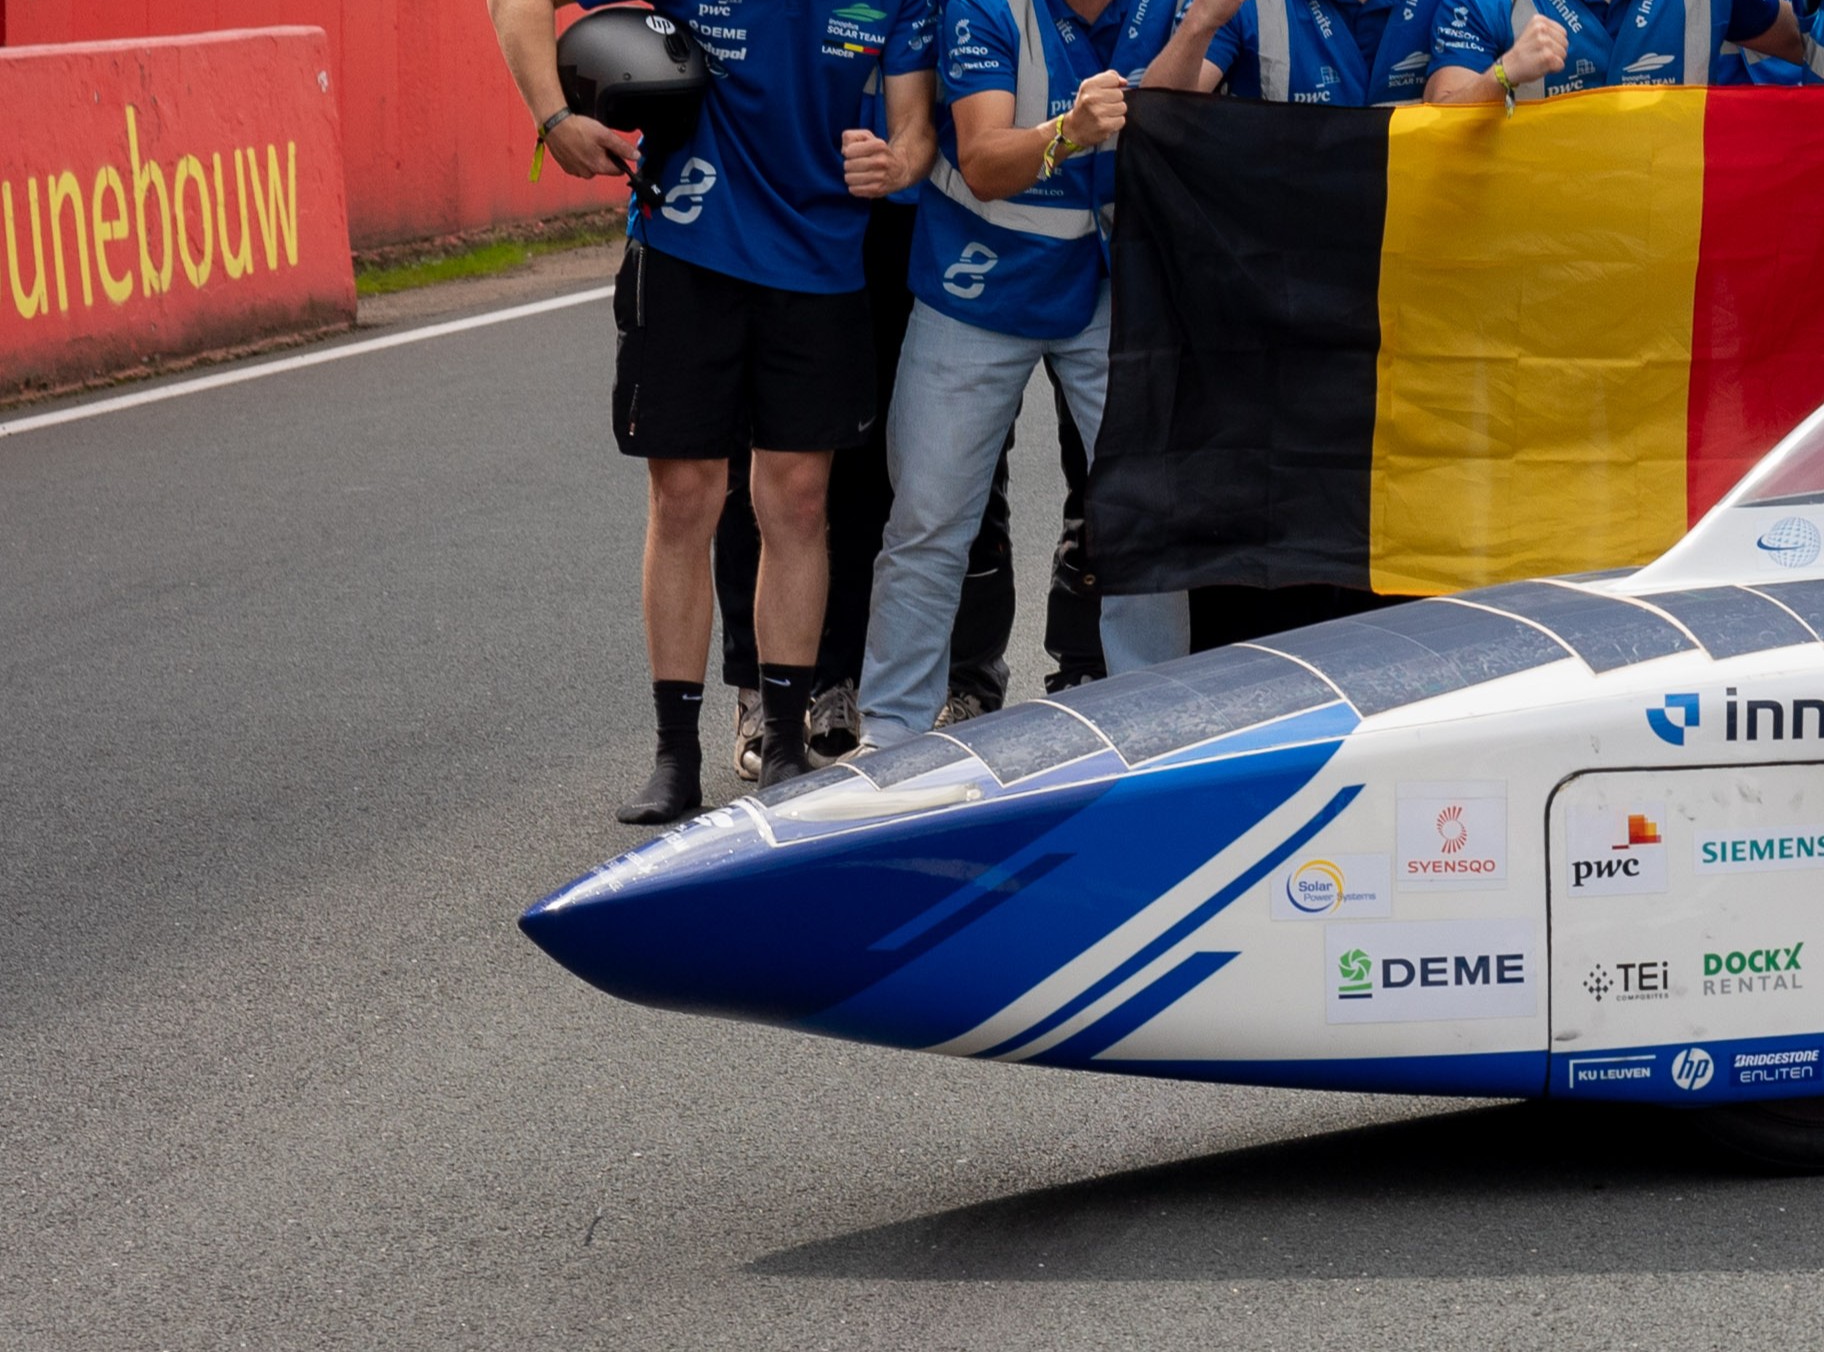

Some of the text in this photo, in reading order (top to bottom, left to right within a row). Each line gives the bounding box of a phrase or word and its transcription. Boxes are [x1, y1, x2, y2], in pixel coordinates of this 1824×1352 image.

[647, 16, 675, 34] hp
[701, 25, 747, 40] DEME
[827, 25, 885, 44] SOLAR TEAM
[822, 46, 855, 59] LANDER
[2, 105, 299, 319] unebouw
[1407, 859, 1496, 874] SYENSQO
[1571, 857, 1640, 887] pwc
[1298, 880, 1333, 893] Solar
[1304, 891, 1376, 903] Power Systems
[1704, 941, 1804, 976] DOCKX
[1382, 953, 1524, 988] DEME
[1616, 961, 1669, 992] TEi
[1703, 973, 1804, 997] RENTAL
[1616, 993, 1669, 1002] COMPOSITES
[1733, 1050, 1820, 1068] BRIDGESTONE
[1578, 1067, 1651, 1081] KU LEUVEN
[1677, 1048, 1709, 1090] hp
[1740, 1066, 1812, 1083] ENLITEN
